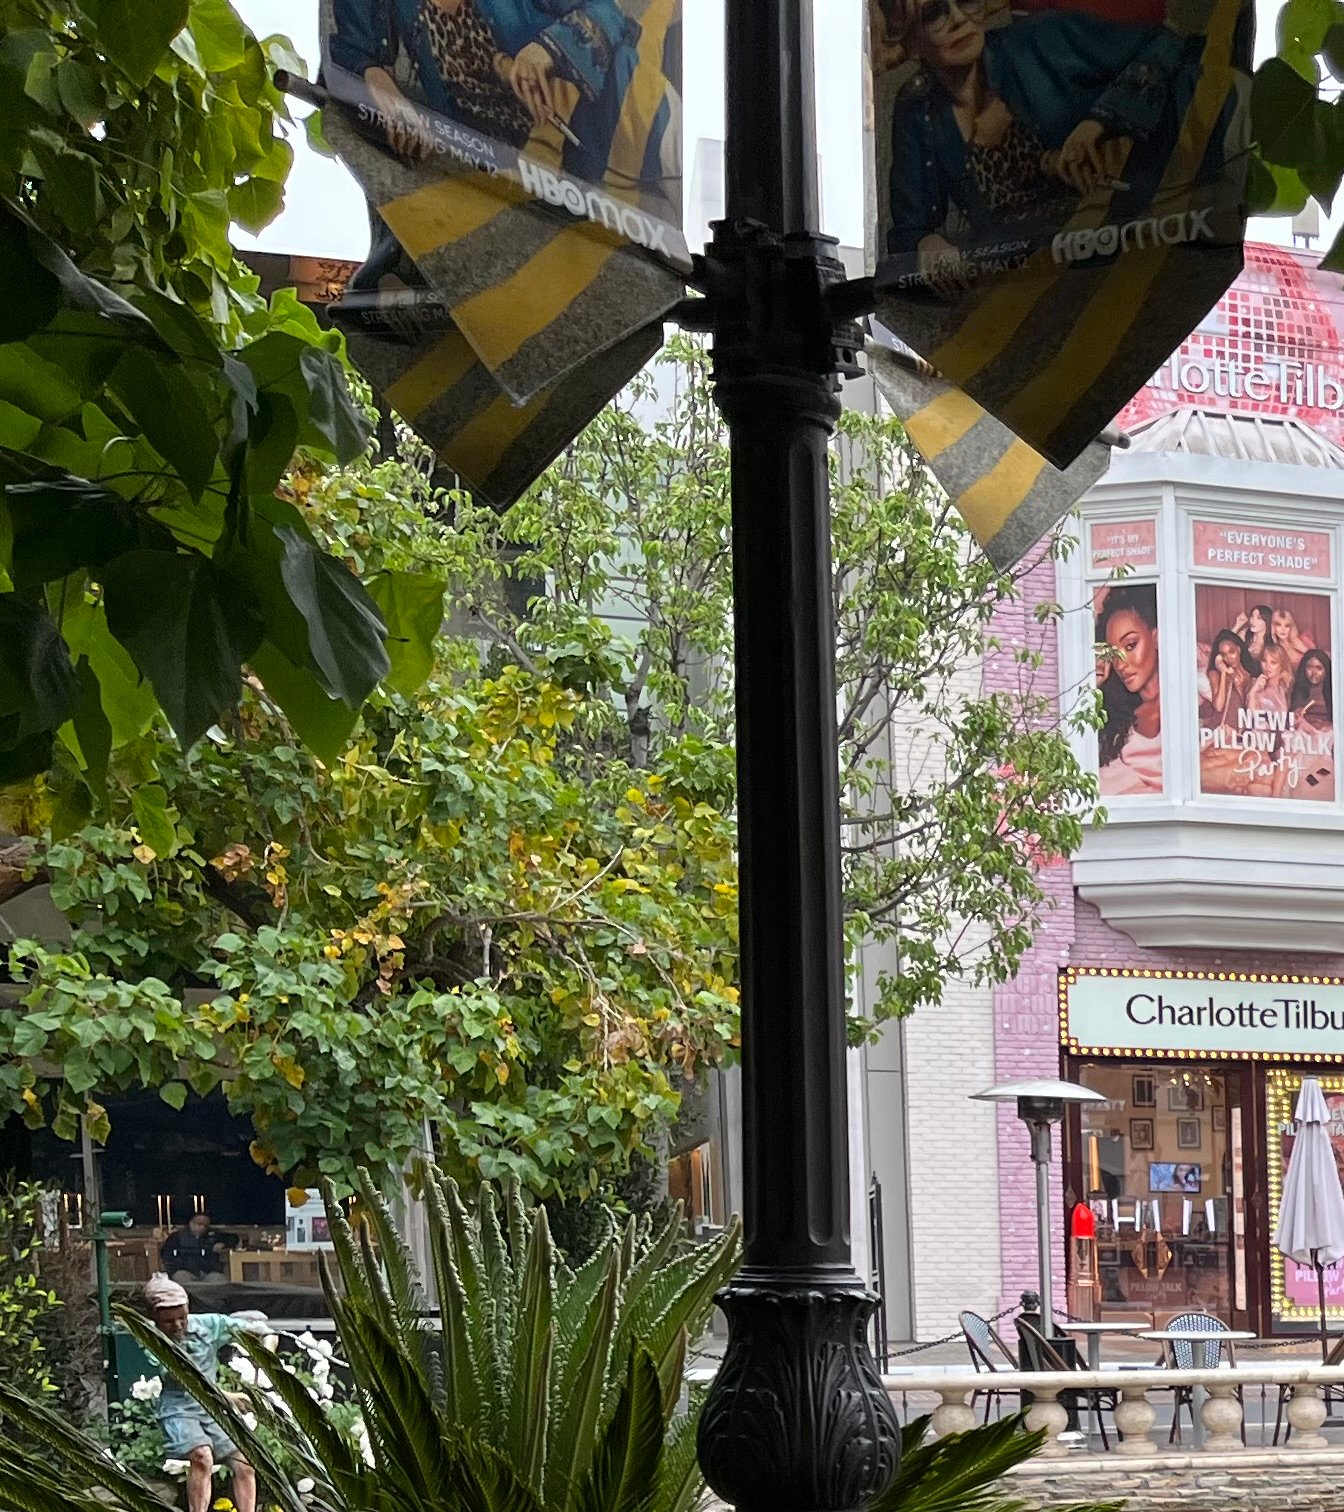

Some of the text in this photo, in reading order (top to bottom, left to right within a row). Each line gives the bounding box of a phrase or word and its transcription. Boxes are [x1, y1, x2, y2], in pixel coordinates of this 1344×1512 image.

[434, 120, 496, 160] SEASON
[450, 145, 481, 168] MAY
[1207, 548, 1265, 566] PERFECT
[1237, 707, 1295, 732] NEW!
[1199, 727, 1333, 756] PILLOW TALK
[1233, 747, 1307, 789] Party
